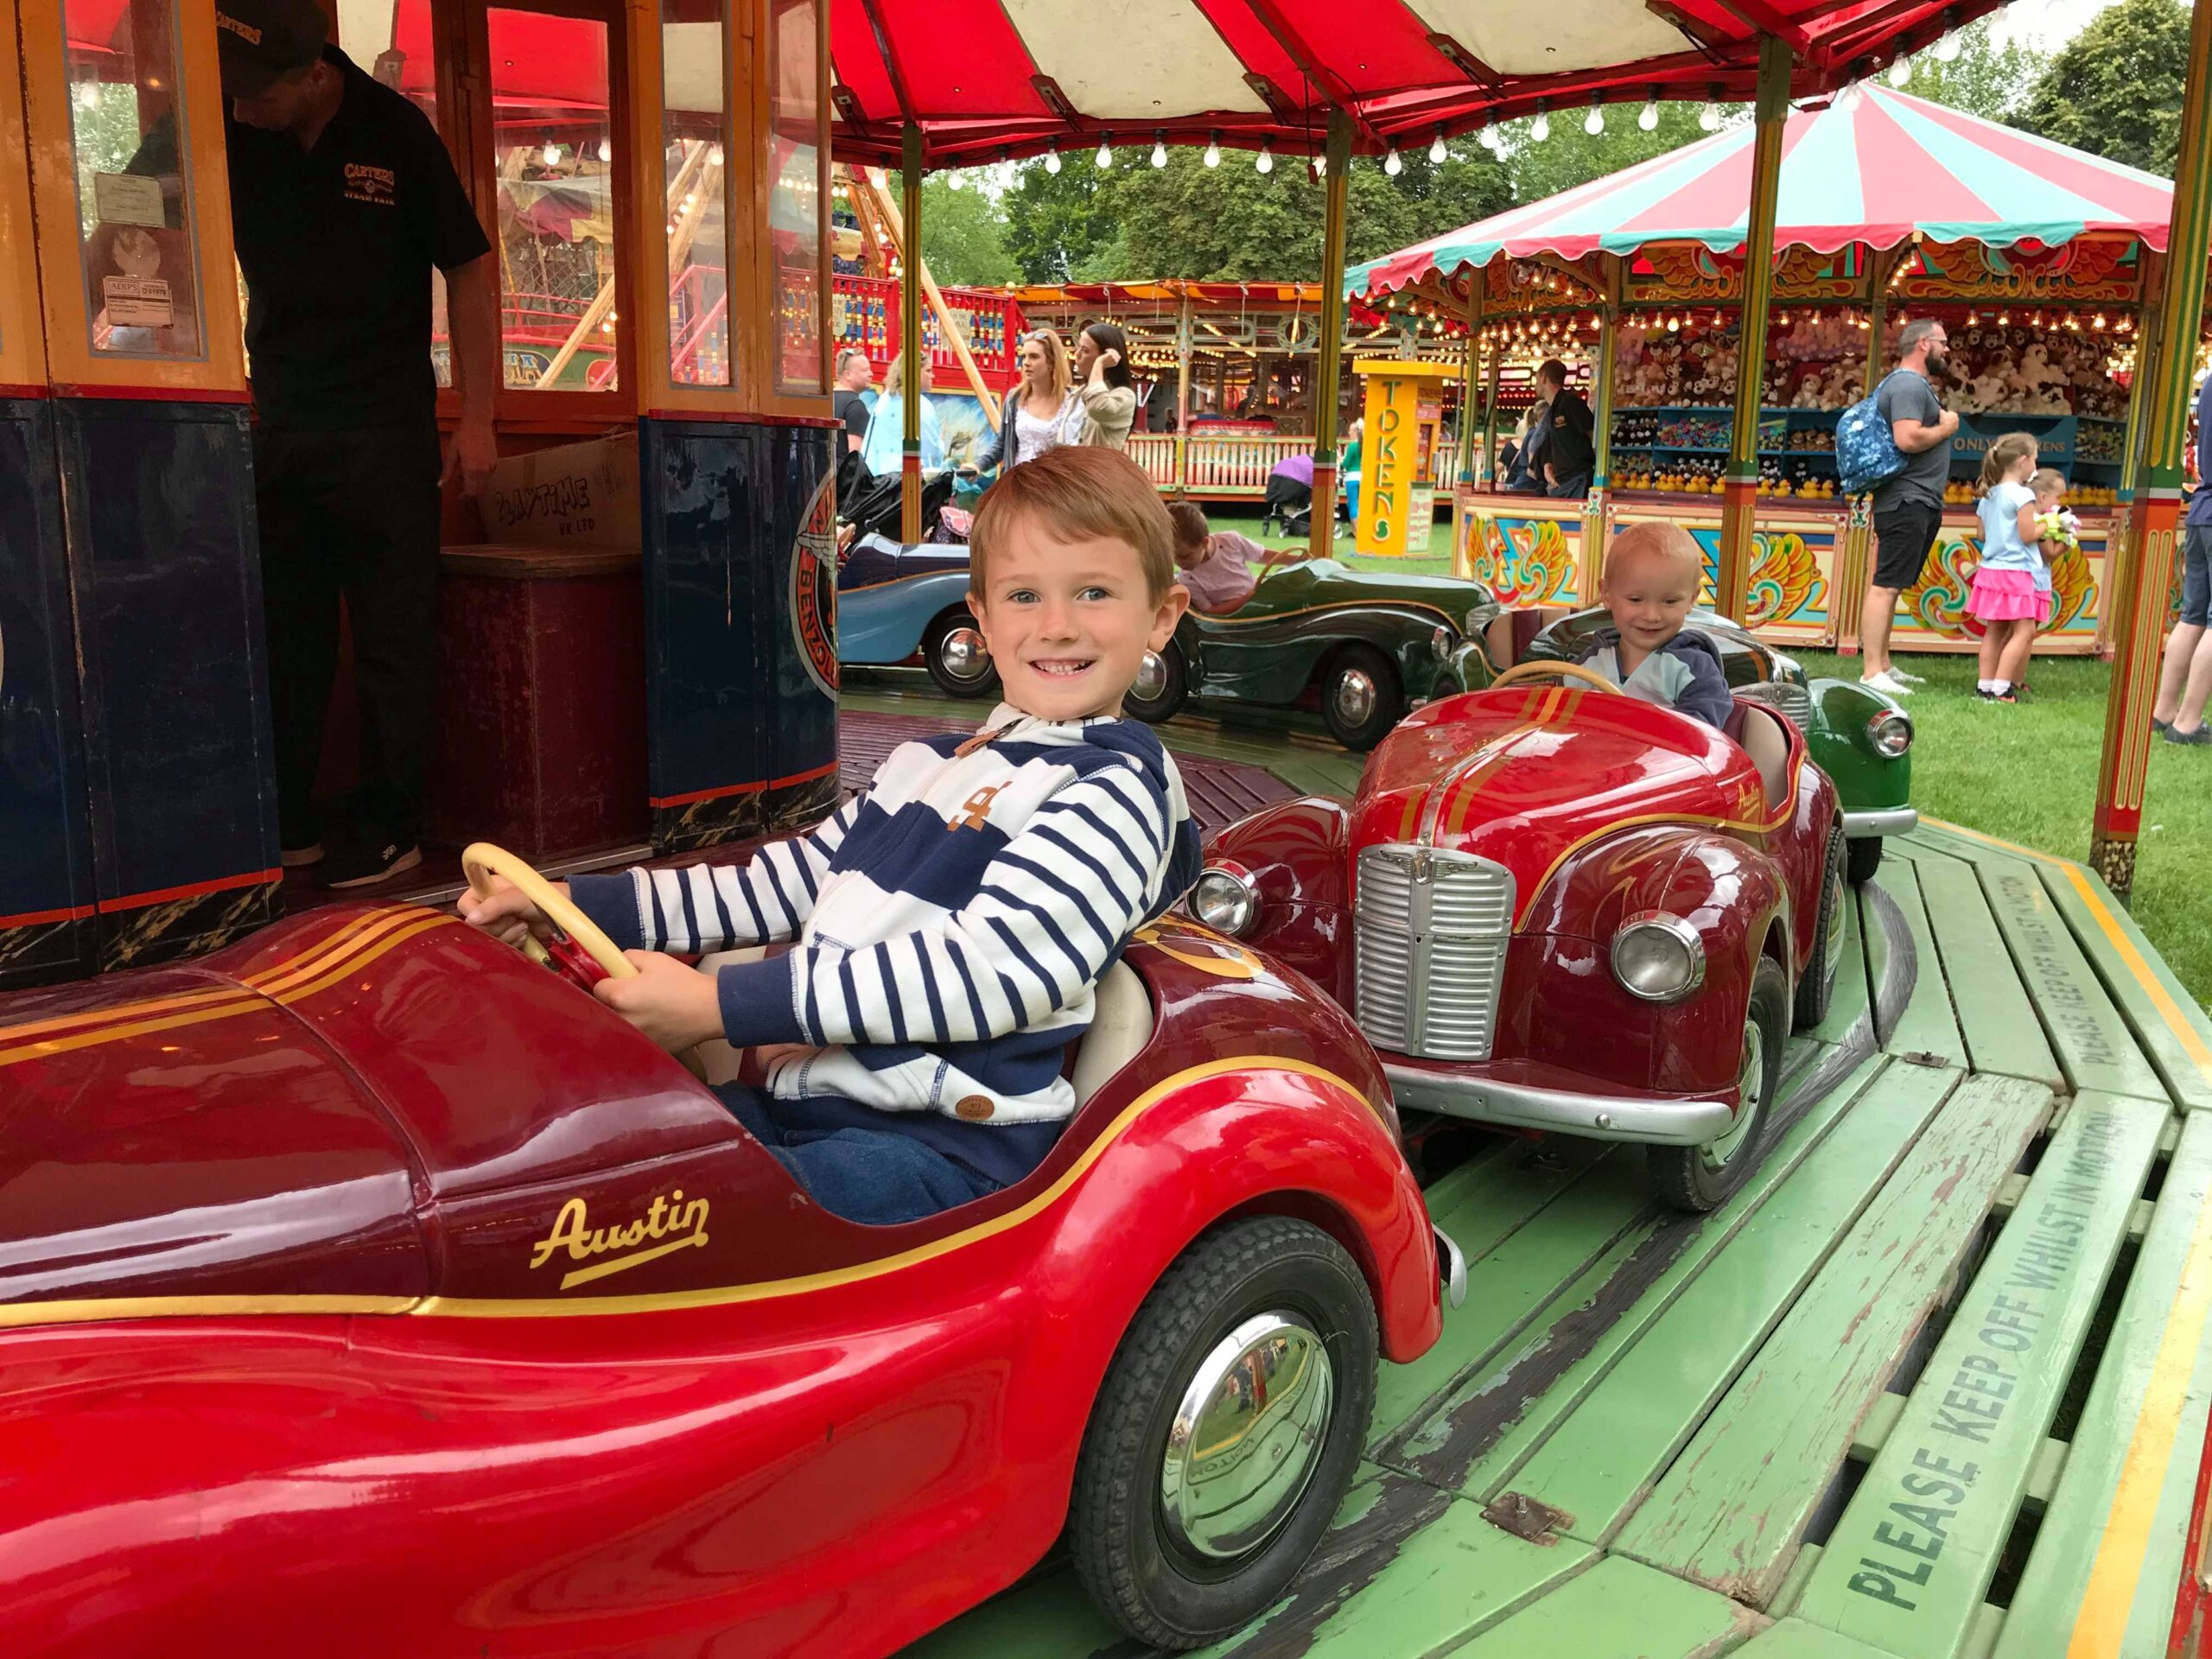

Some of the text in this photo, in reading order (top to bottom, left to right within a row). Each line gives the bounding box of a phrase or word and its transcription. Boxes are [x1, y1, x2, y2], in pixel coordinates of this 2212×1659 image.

[344, 162, 395, 186] CARTERS
[111, 283, 137, 291] ADIPS
[1953, 436, 1998, 452] ONLY
[1371, 380, 1402, 542] TOKENS
[576, 518, 595, 533] LTD
[2044, 979, 2089, 1010] KEEP
[2060, 1013, 2120, 1066] PLEASE
[529, 1189, 710, 1290] Austin
[1847, 1111, 2131, 1612] PLEASE KEEP OFF WHILST IN MOTION
